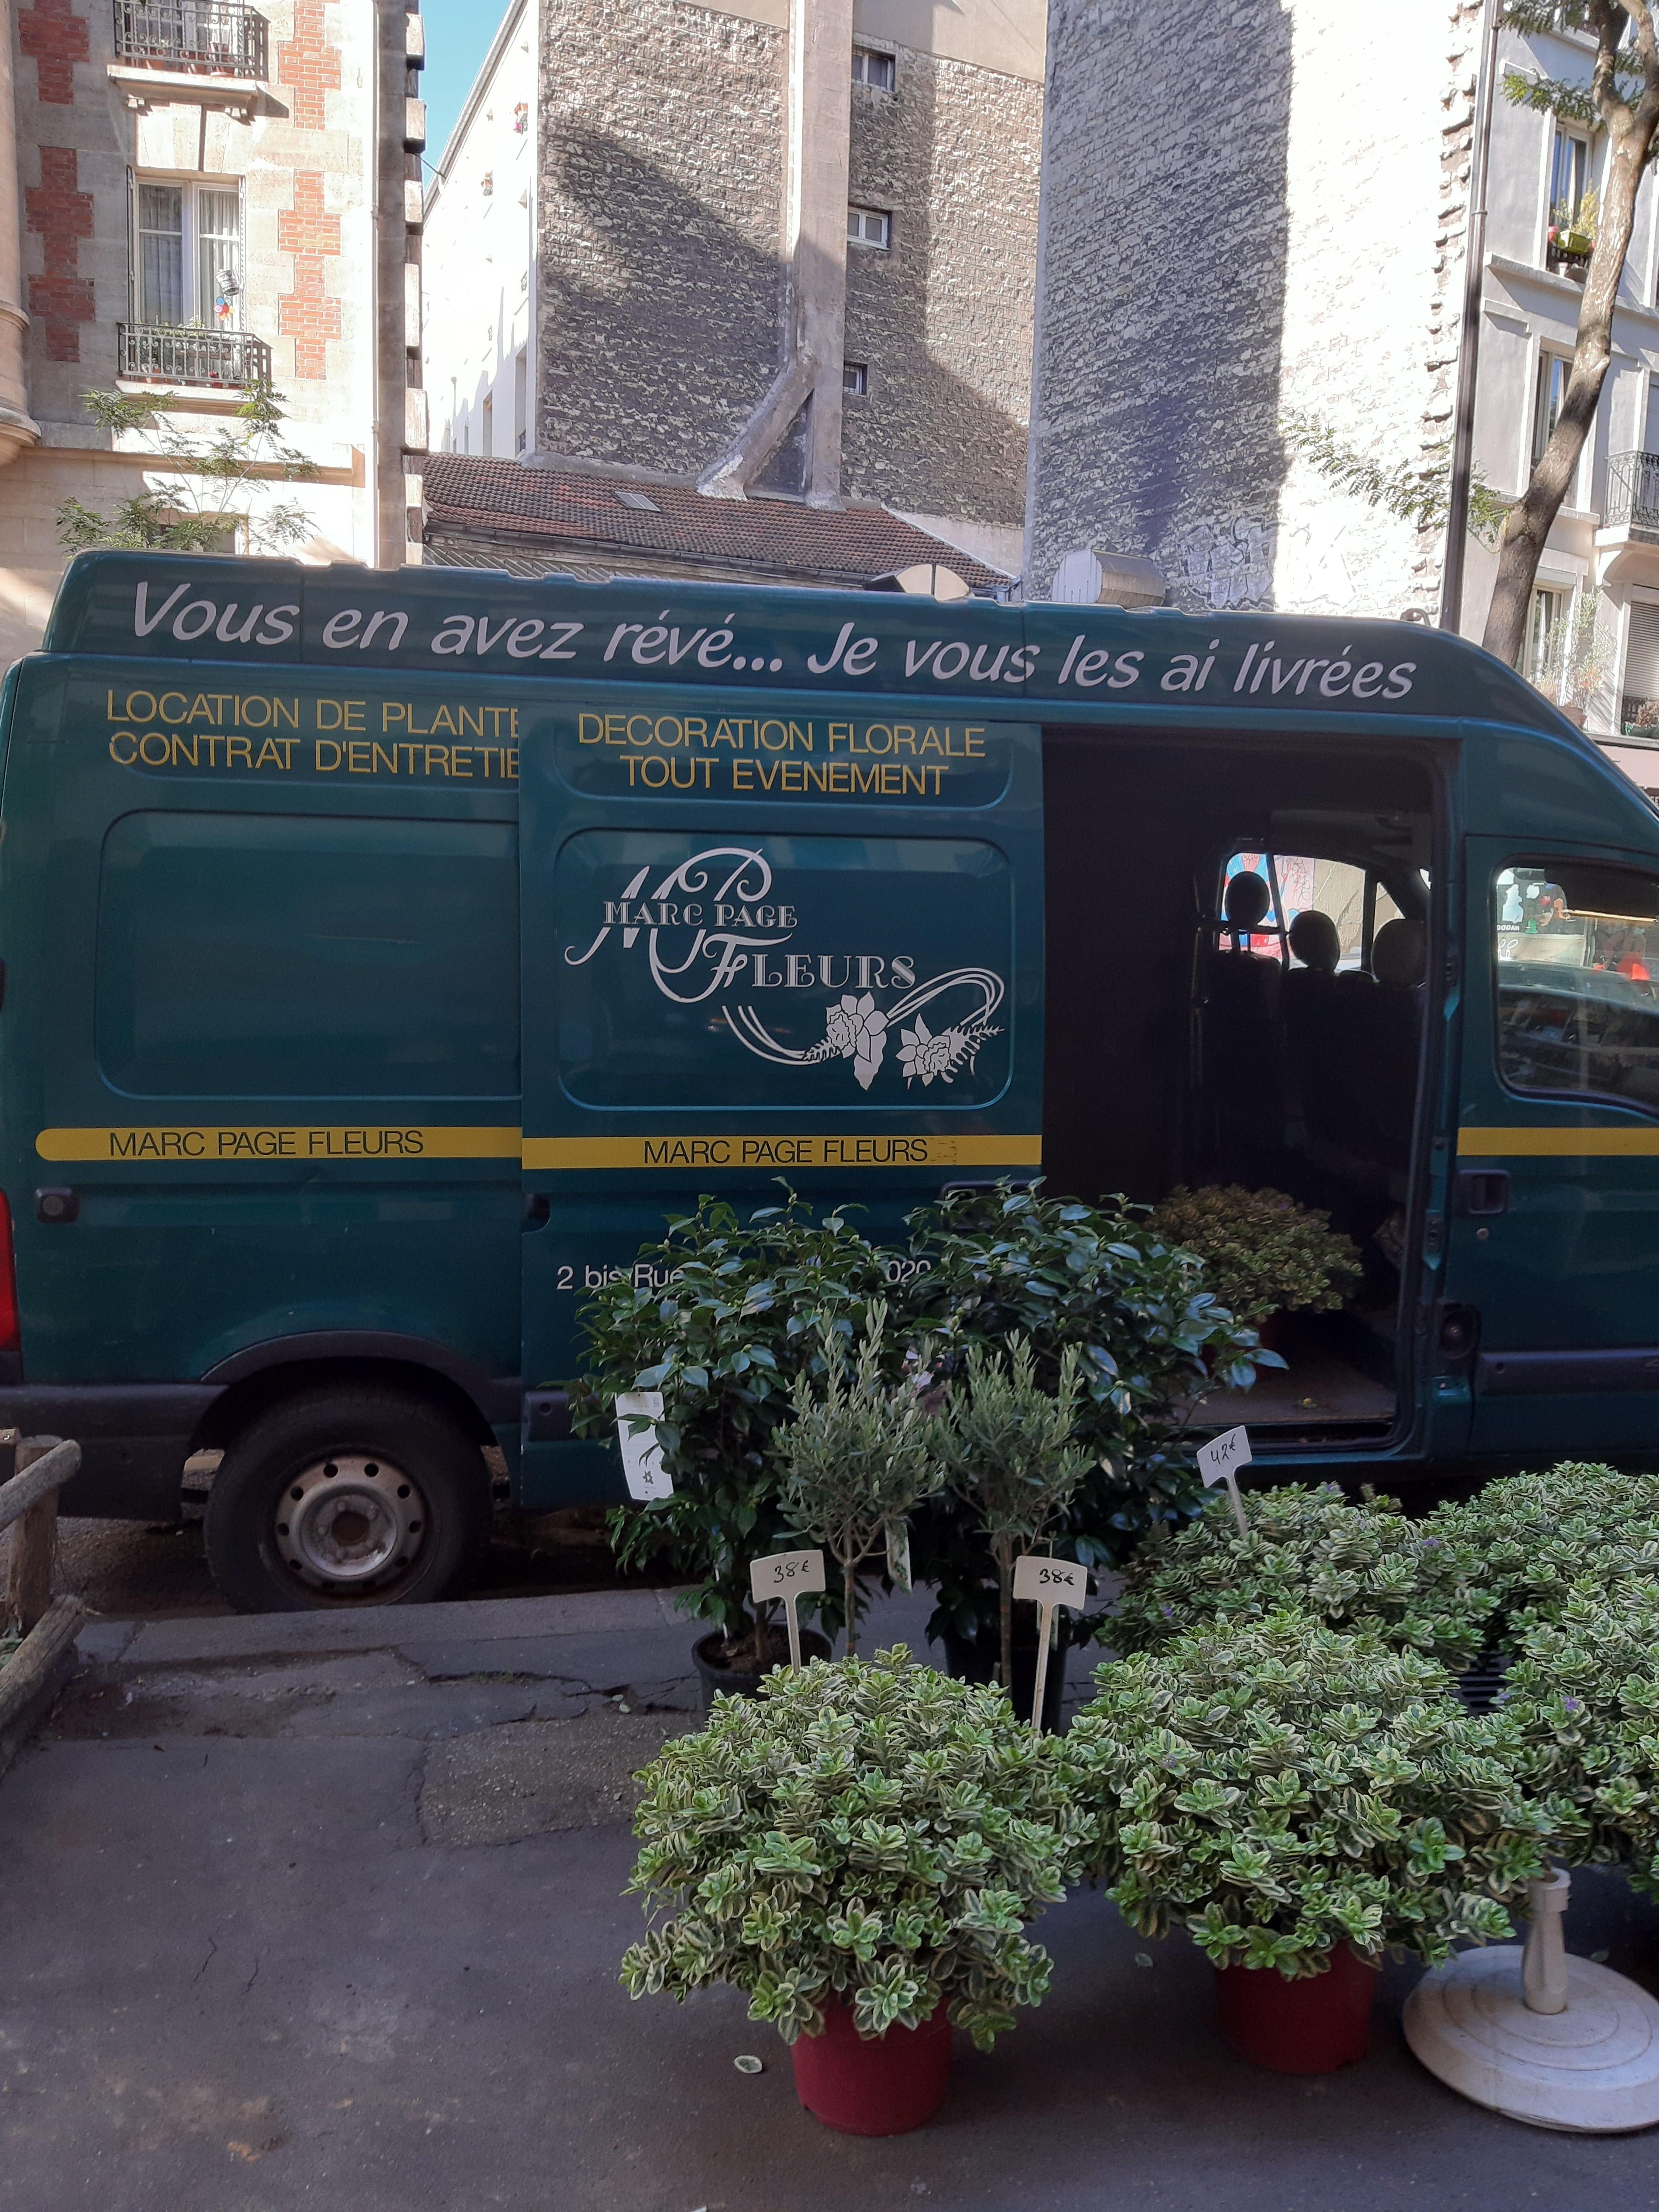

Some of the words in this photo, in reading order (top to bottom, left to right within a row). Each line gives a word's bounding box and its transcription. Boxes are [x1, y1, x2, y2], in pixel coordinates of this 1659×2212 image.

[135, 582, 300, 645] Vous
[322, 610, 409, 650] en
[431, 615, 584, 659] avez
[807, 622, 878, 675] Je
[905, 640, 1041, 683] vous
[1058, 635, 1144, 688] les
[1161, 639, 1220, 691] ai
[1233, 640, 1417, 699] livrées
[107, 690, 299, 729] LOCATION
[316, 699, 366, 731] DE
[109, 732, 301, 770] CONTRAT
[578, 714, 813, 751] DECORATION
[828, 723, 986, 757] FLORALE
[619, 755, 719, 788] TOUT
[733, 759, 949, 796] EVENEMENT
[603, 901, 703, 926] MARC
[714, 904, 798, 928] PAGE
[702, 933, 916, 989] FLEURS
[110, 1131, 205, 1156] MARC
[218, 1131, 296, 1155] PAGE
[309, 1130, 424, 1154] FLEURS
[644, 1141, 731, 1164] MARC
[742, 1140, 813, 1163] PAGE
[824, 1138, 928, 1162] FLEURS
[556, 1265, 573, 1289] 2
[634, 1263, 685, 1288] Rue
[773, 1559, 809, 1583] 38€
[1040, 1568, 1074, 1586] 38€
